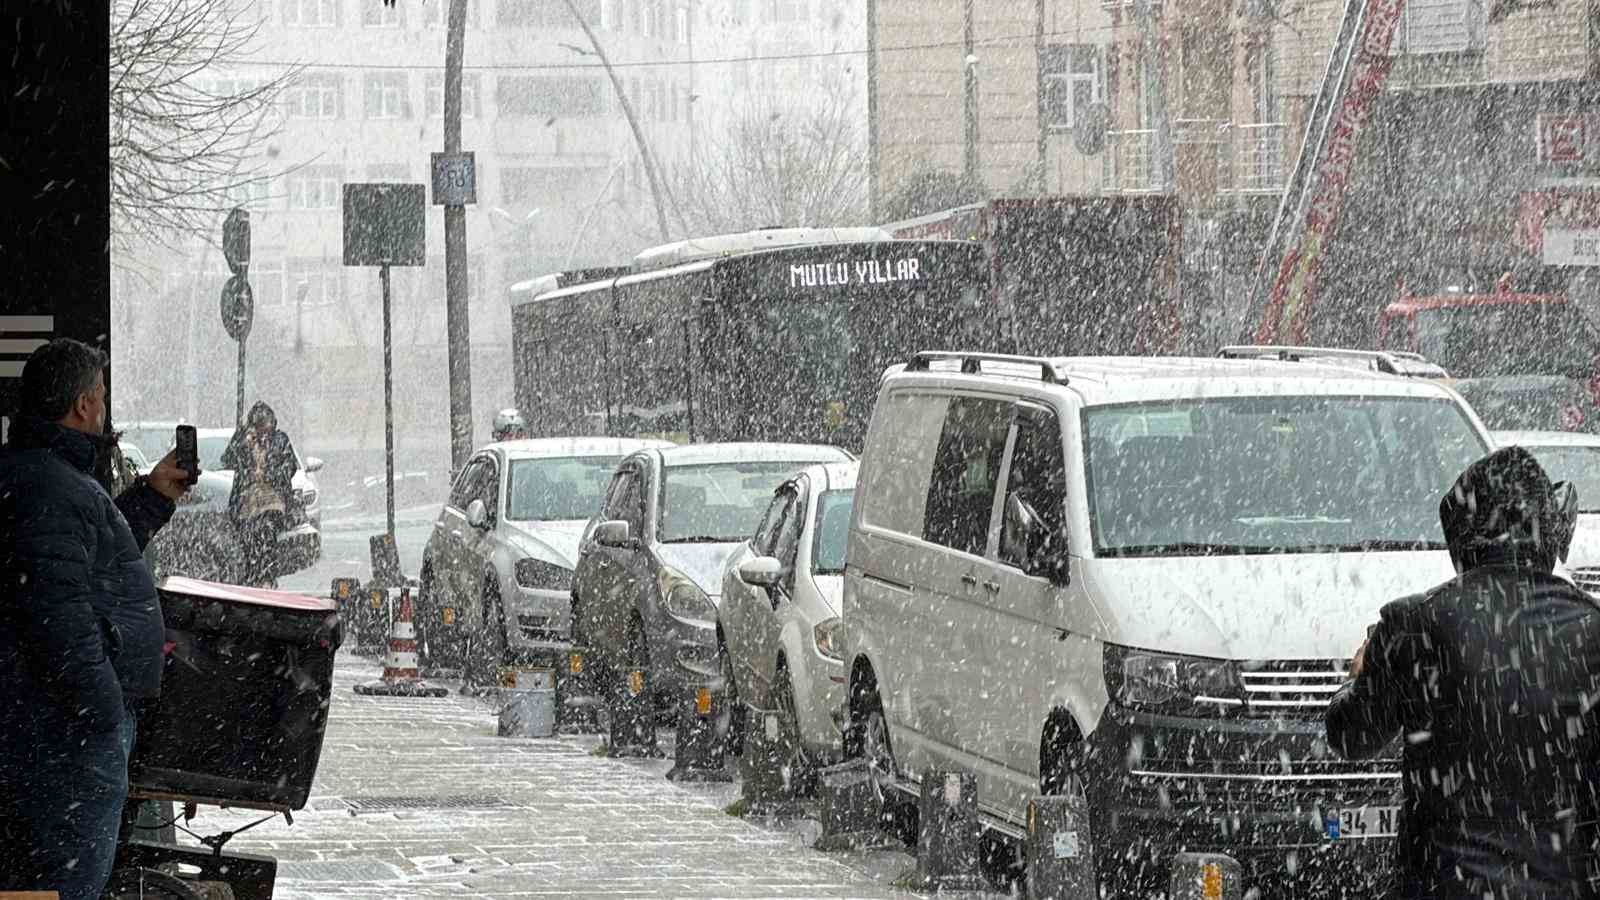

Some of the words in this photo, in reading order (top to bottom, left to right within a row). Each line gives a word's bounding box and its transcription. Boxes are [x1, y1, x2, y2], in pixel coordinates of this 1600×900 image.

[790, 262, 849, 287] MUTLU
[855, 257, 921, 283] YILLAR
[1341, 810, 1367, 834] 34
